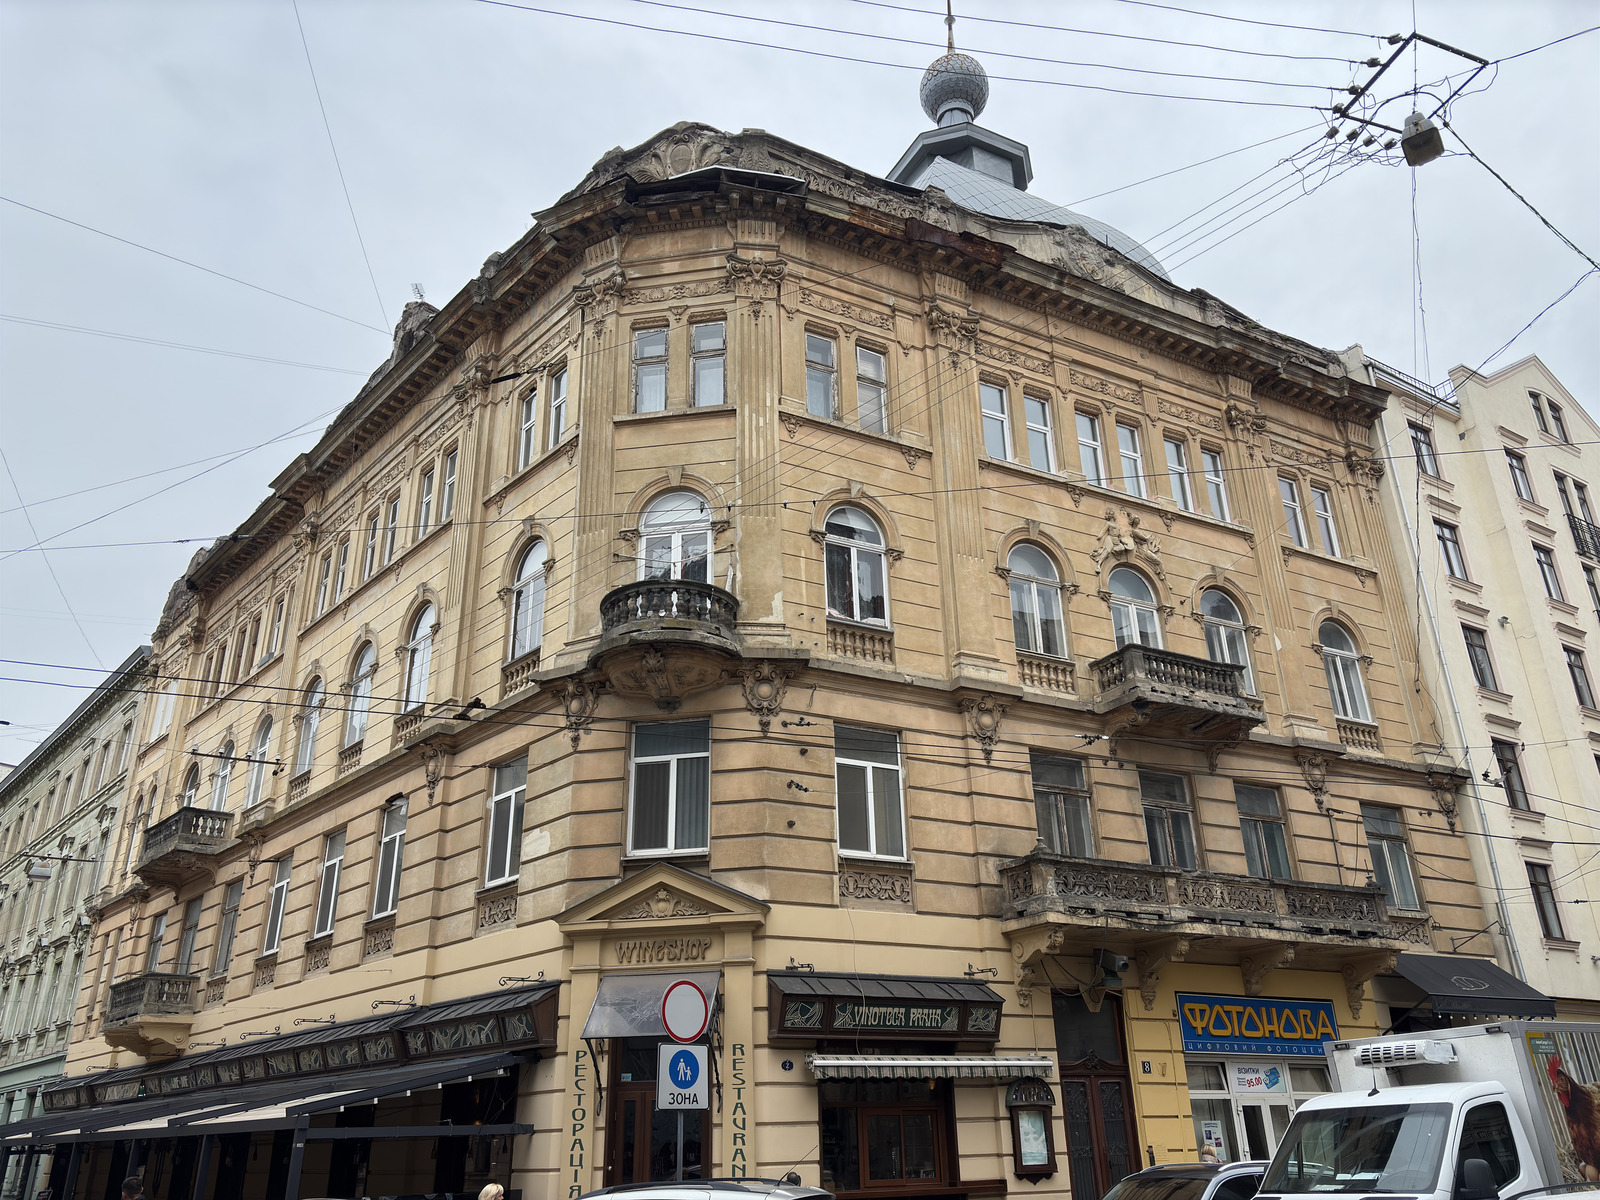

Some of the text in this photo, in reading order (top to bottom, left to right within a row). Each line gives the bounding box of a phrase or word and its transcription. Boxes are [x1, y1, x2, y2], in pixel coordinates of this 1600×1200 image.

[909, 1008, 942, 1027] PRAHA
[1183, 1002, 1337, 1040] ФОТОНОВА
[1187, 1042, 1324, 1054] ЦИФРОВИЙ ФОТОЦЕН
[1144, 1062, 1150, 1073] 8
[1246, 1076, 1263, 1088] 95.00
[668, 1092, 699, 1105] ЗОНА
[731, 1044, 747, 1184] RESTAURAN
